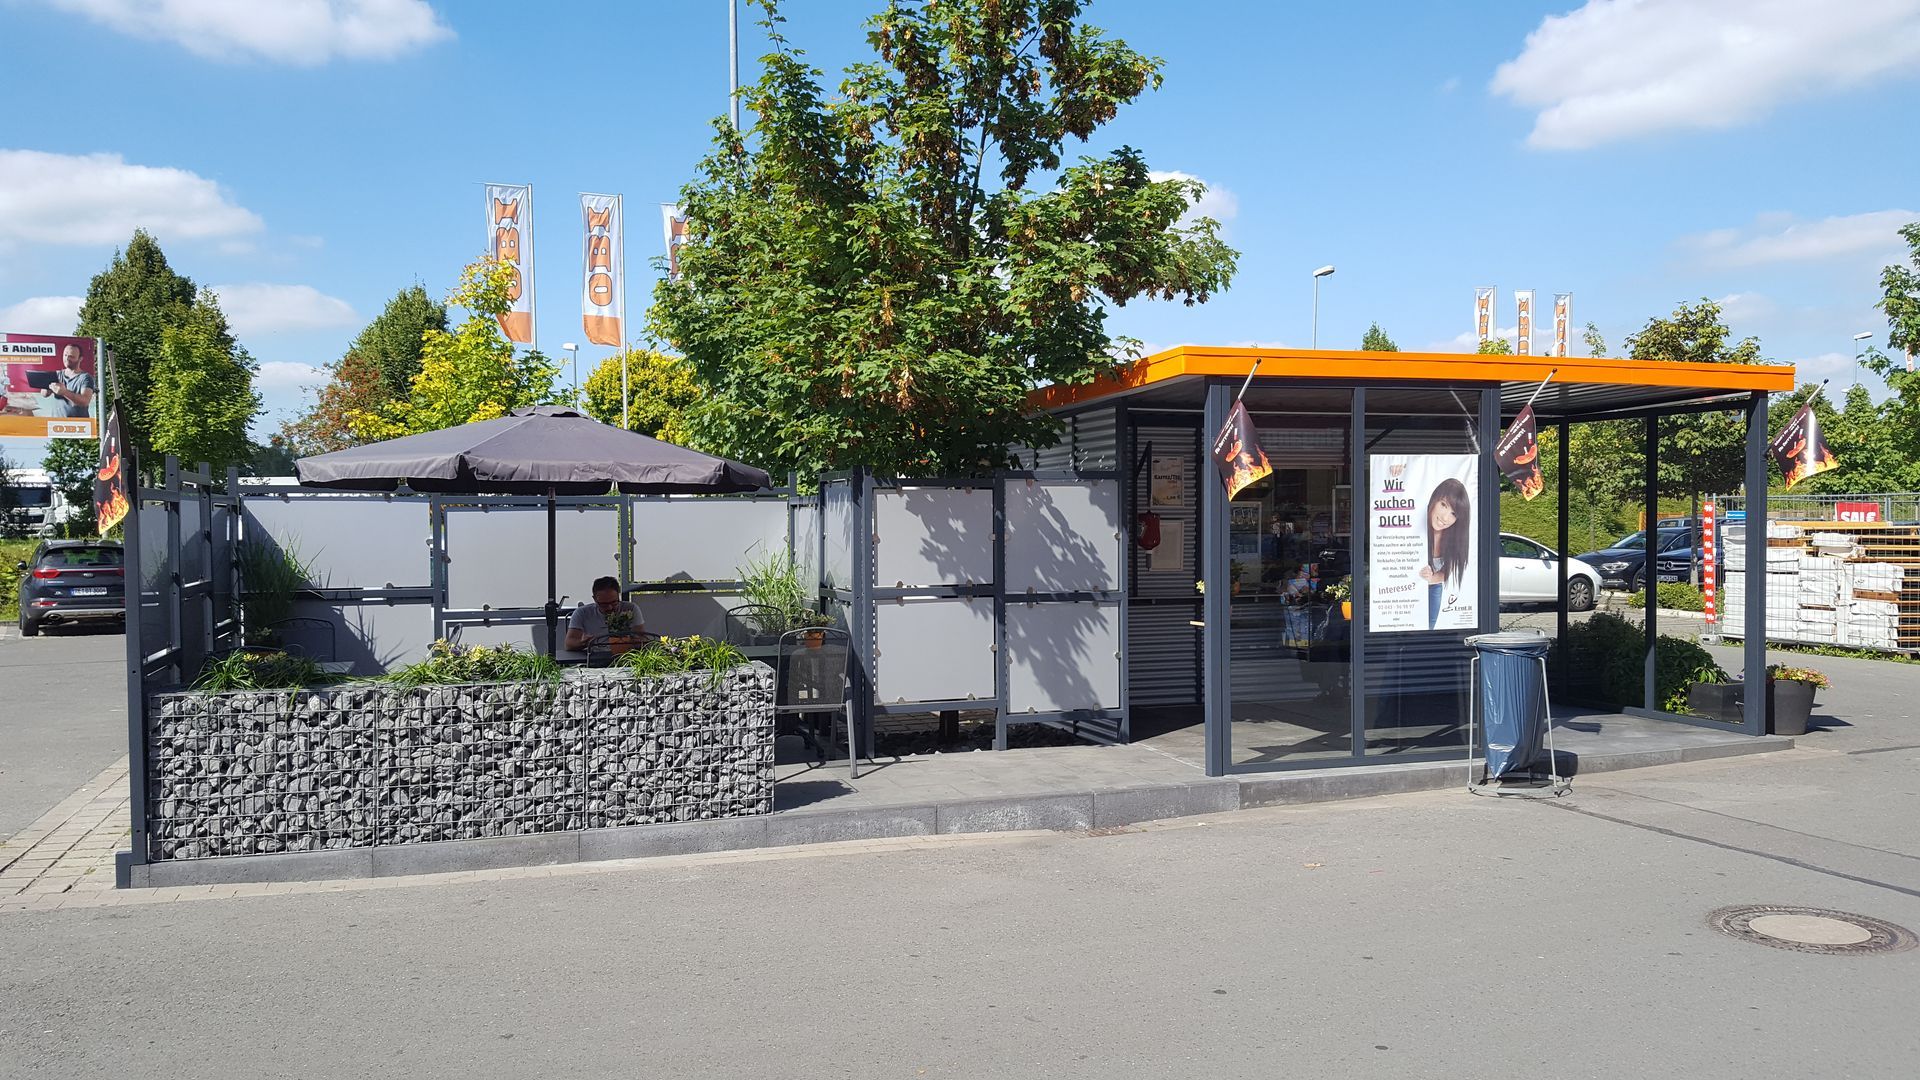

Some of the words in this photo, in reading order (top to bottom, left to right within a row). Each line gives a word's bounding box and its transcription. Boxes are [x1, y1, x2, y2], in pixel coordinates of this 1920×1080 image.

[588, 207, 612, 306] OBI
[2, 345, 9, 353] &
[12, 345, 53, 354] Abholen
[52, 425, 86, 433] OBI
[1384, 478, 1403, 490] Wir
[1374, 496, 1415, 509] suchen
[1379, 515, 1410, 527] DICH!
[1378, 582, 1416, 594] Interesse?
